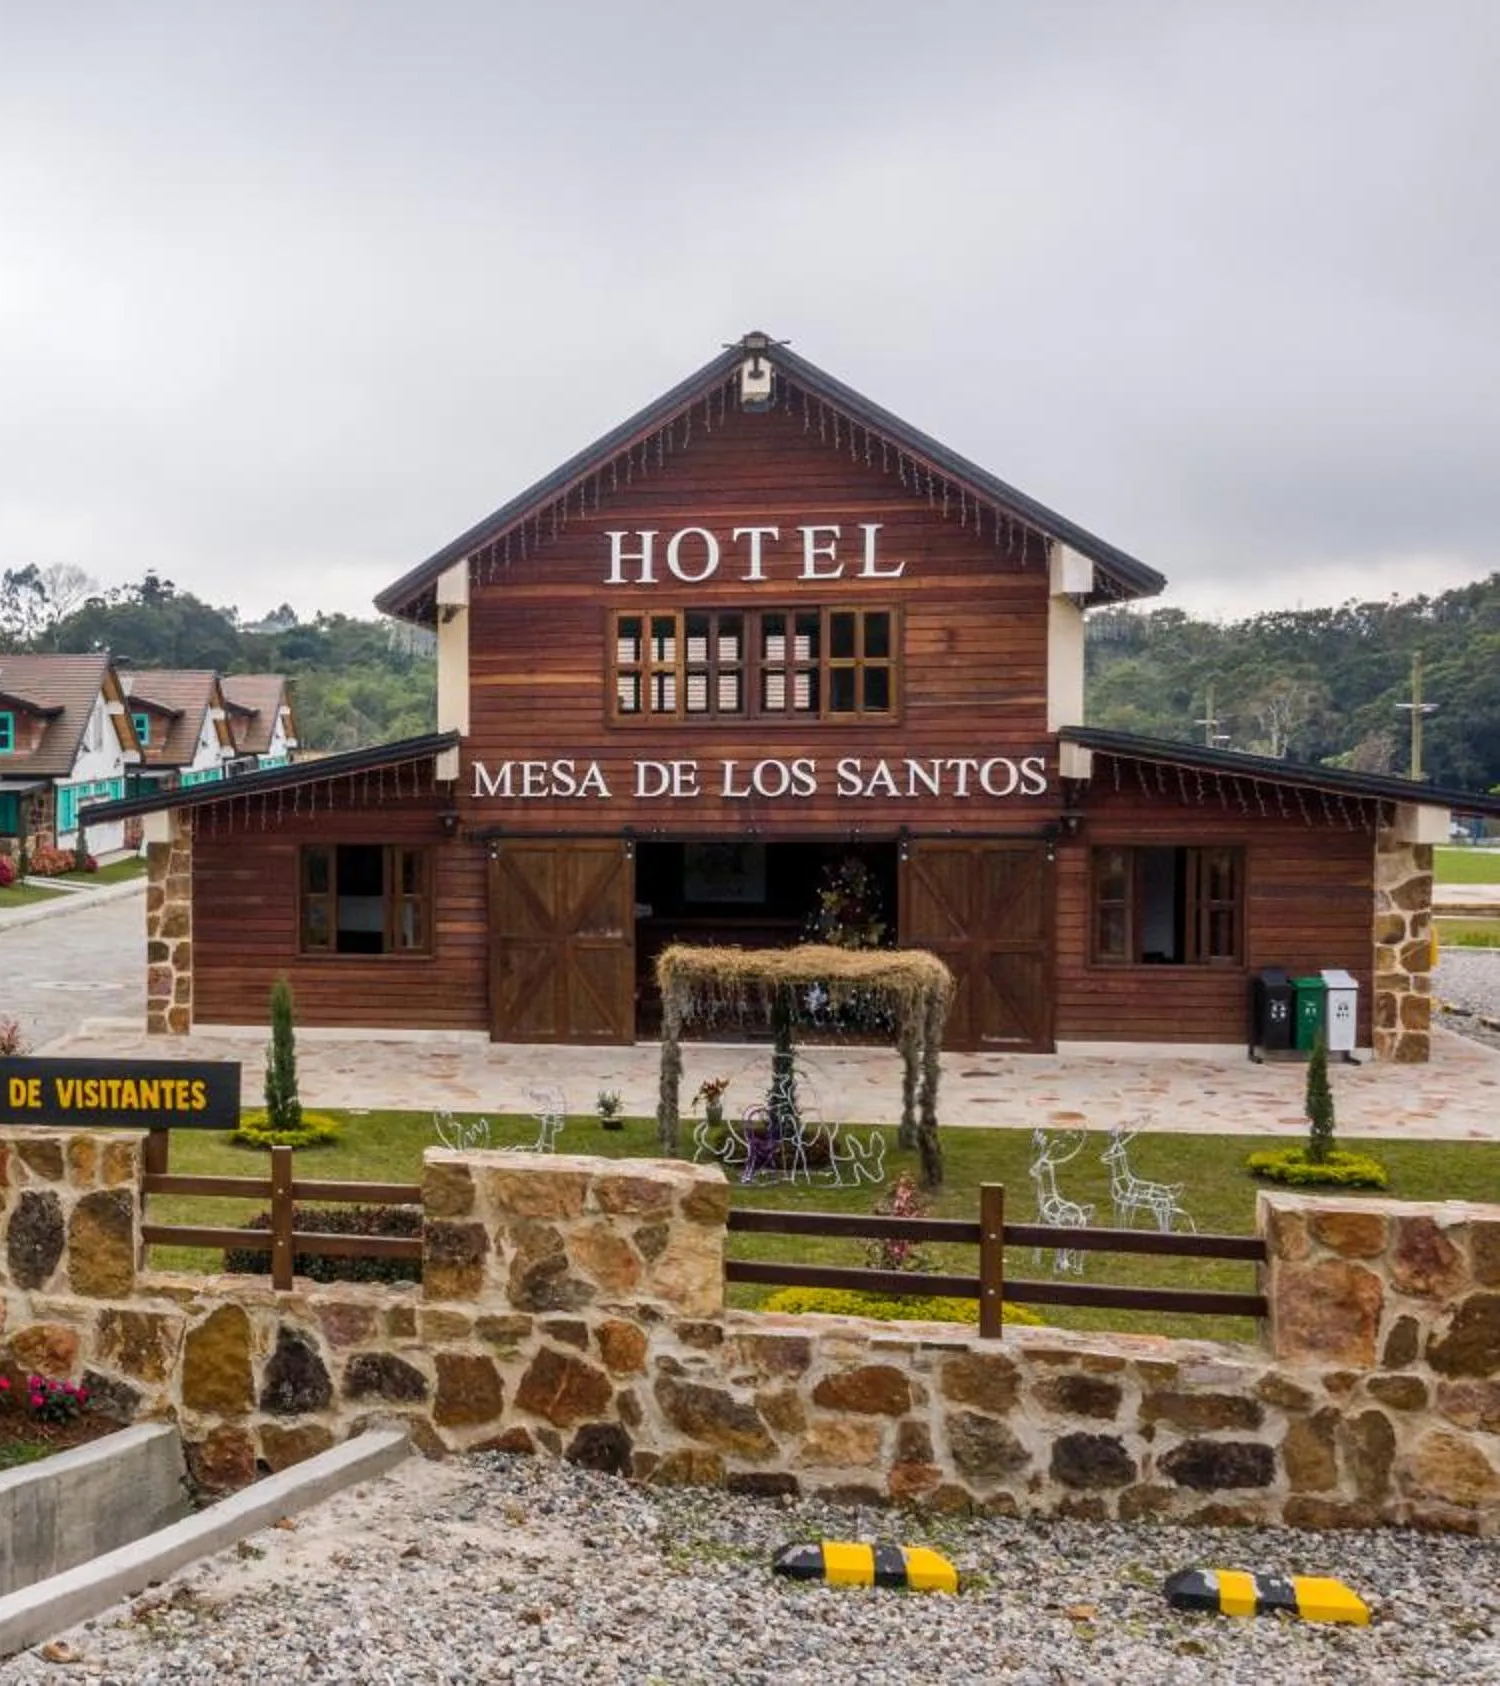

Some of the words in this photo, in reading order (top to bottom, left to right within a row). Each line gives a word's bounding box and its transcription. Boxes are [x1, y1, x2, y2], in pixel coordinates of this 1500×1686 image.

[603, 522, 906, 584] HOTEL
[471, 759, 612, 798] MESA
[633, 760, 699, 797] DE
[722, 758, 818, 797] LOS
[837, 757, 1048, 797] SANTOS
[8, 1077, 42, 1108] DE
[55, 1078, 207, 1110] VISITANTES
